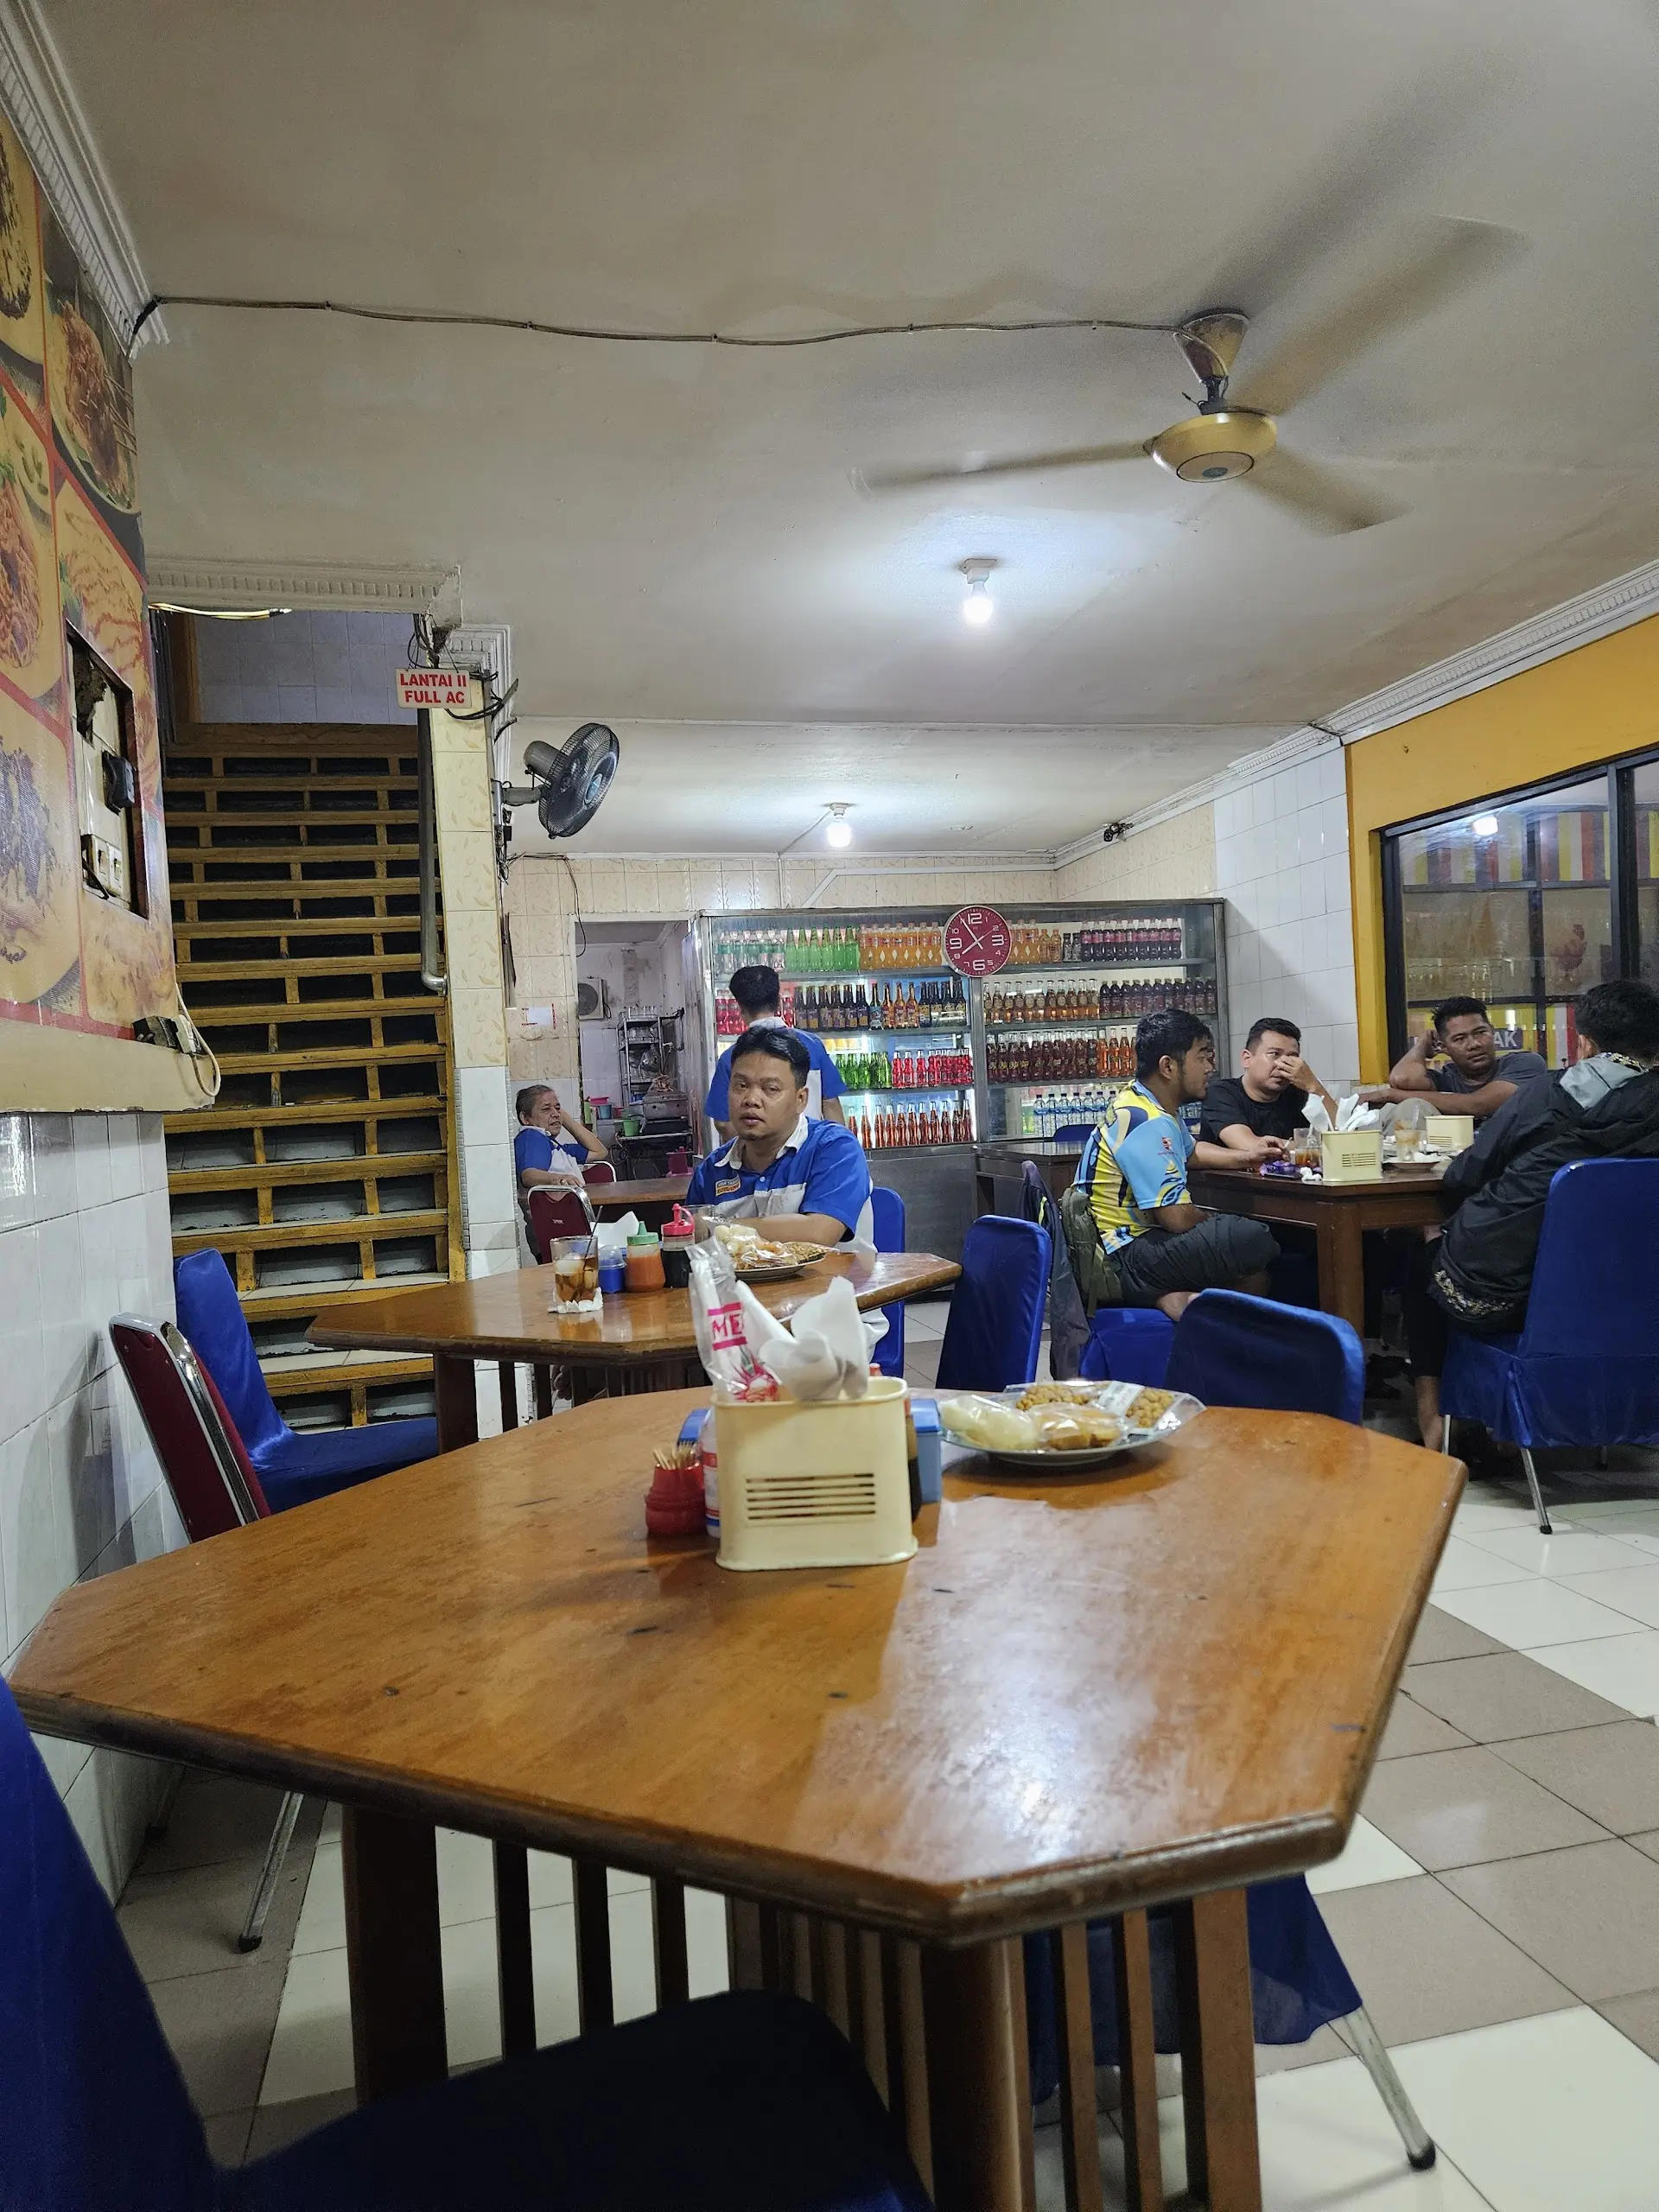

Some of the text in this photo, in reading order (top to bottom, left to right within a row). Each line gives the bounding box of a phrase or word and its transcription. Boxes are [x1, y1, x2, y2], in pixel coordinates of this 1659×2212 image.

[400, 673, 467, 687] LANTAI II
[404, 690, 465, 703] FULL AC
[968, 912, 982, 925] 12
[950, 938, 963, 950] 9
[991, 934, 1004, 946] 3
[972, 959, 986, 971] 6
